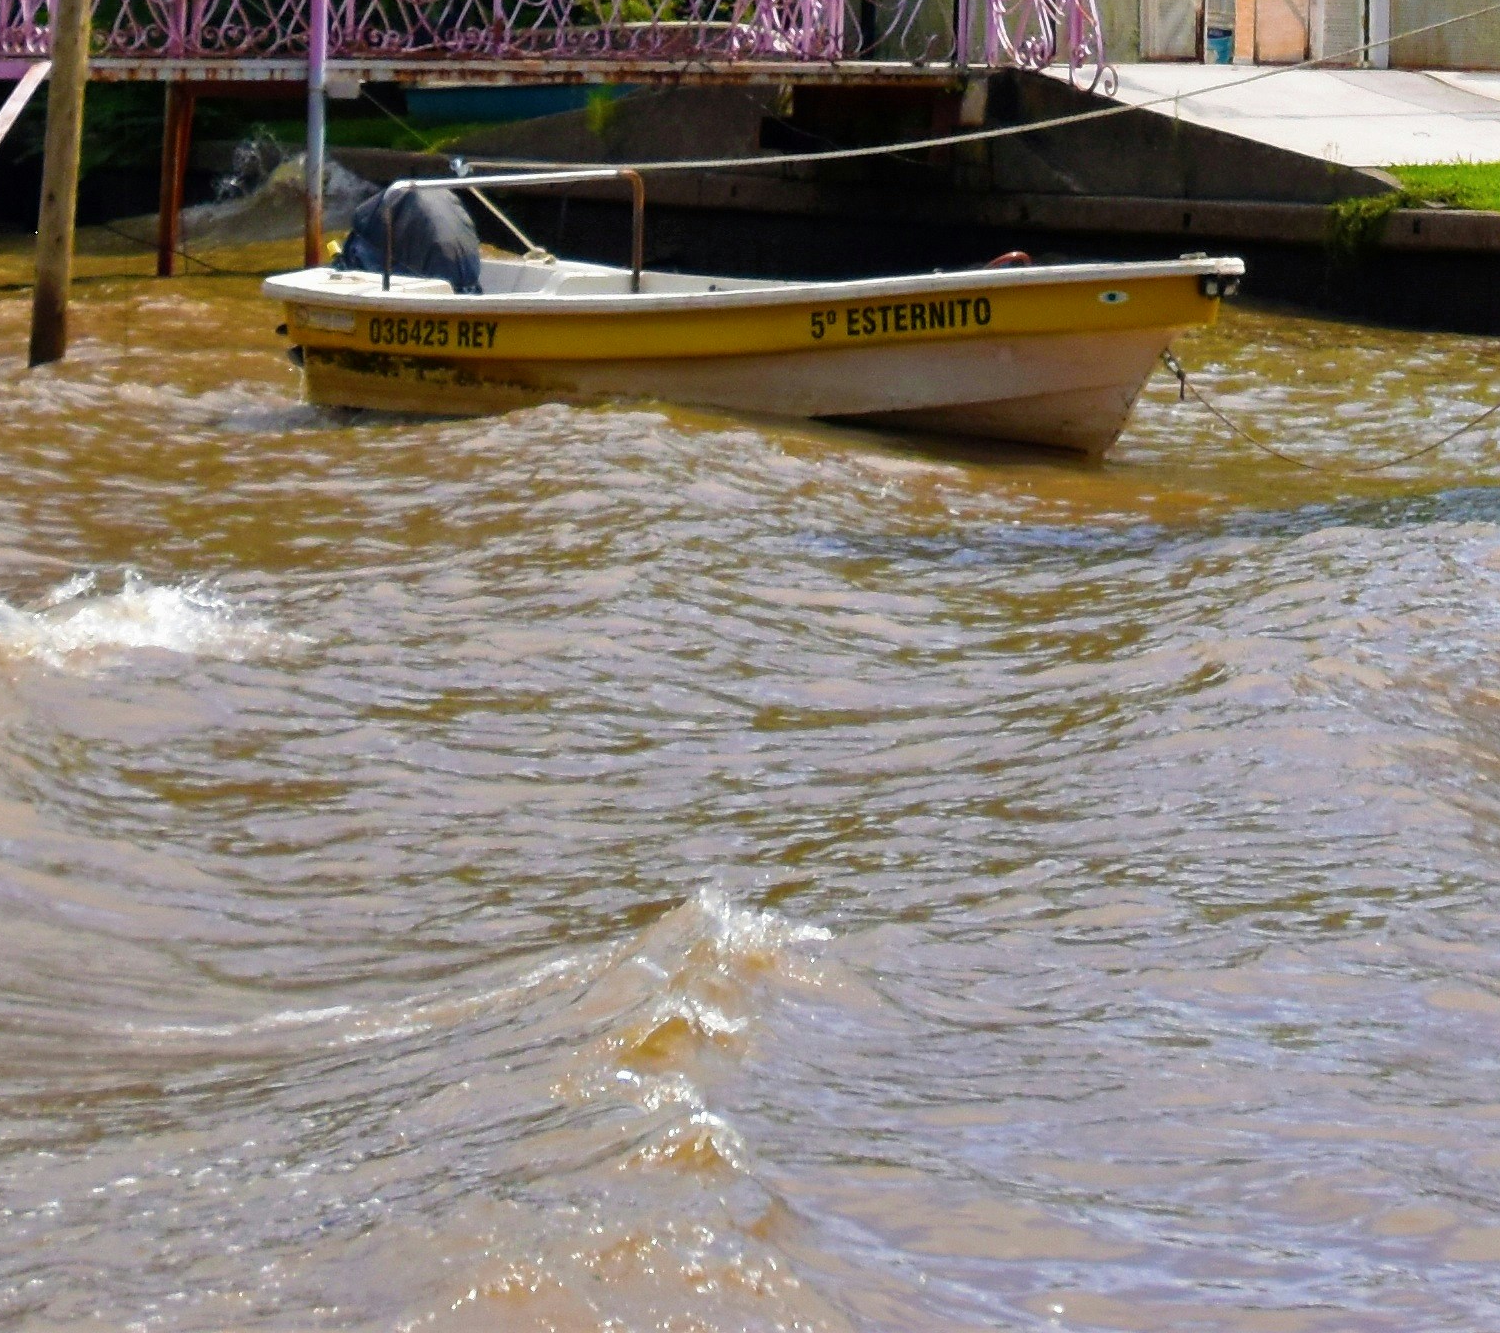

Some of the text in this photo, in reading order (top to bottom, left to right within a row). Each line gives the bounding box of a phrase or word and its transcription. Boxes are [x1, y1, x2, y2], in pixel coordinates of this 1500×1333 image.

[369, 317, 499, 349] 036425 REY
[846, 297, 992, 336] ESTERNITO
